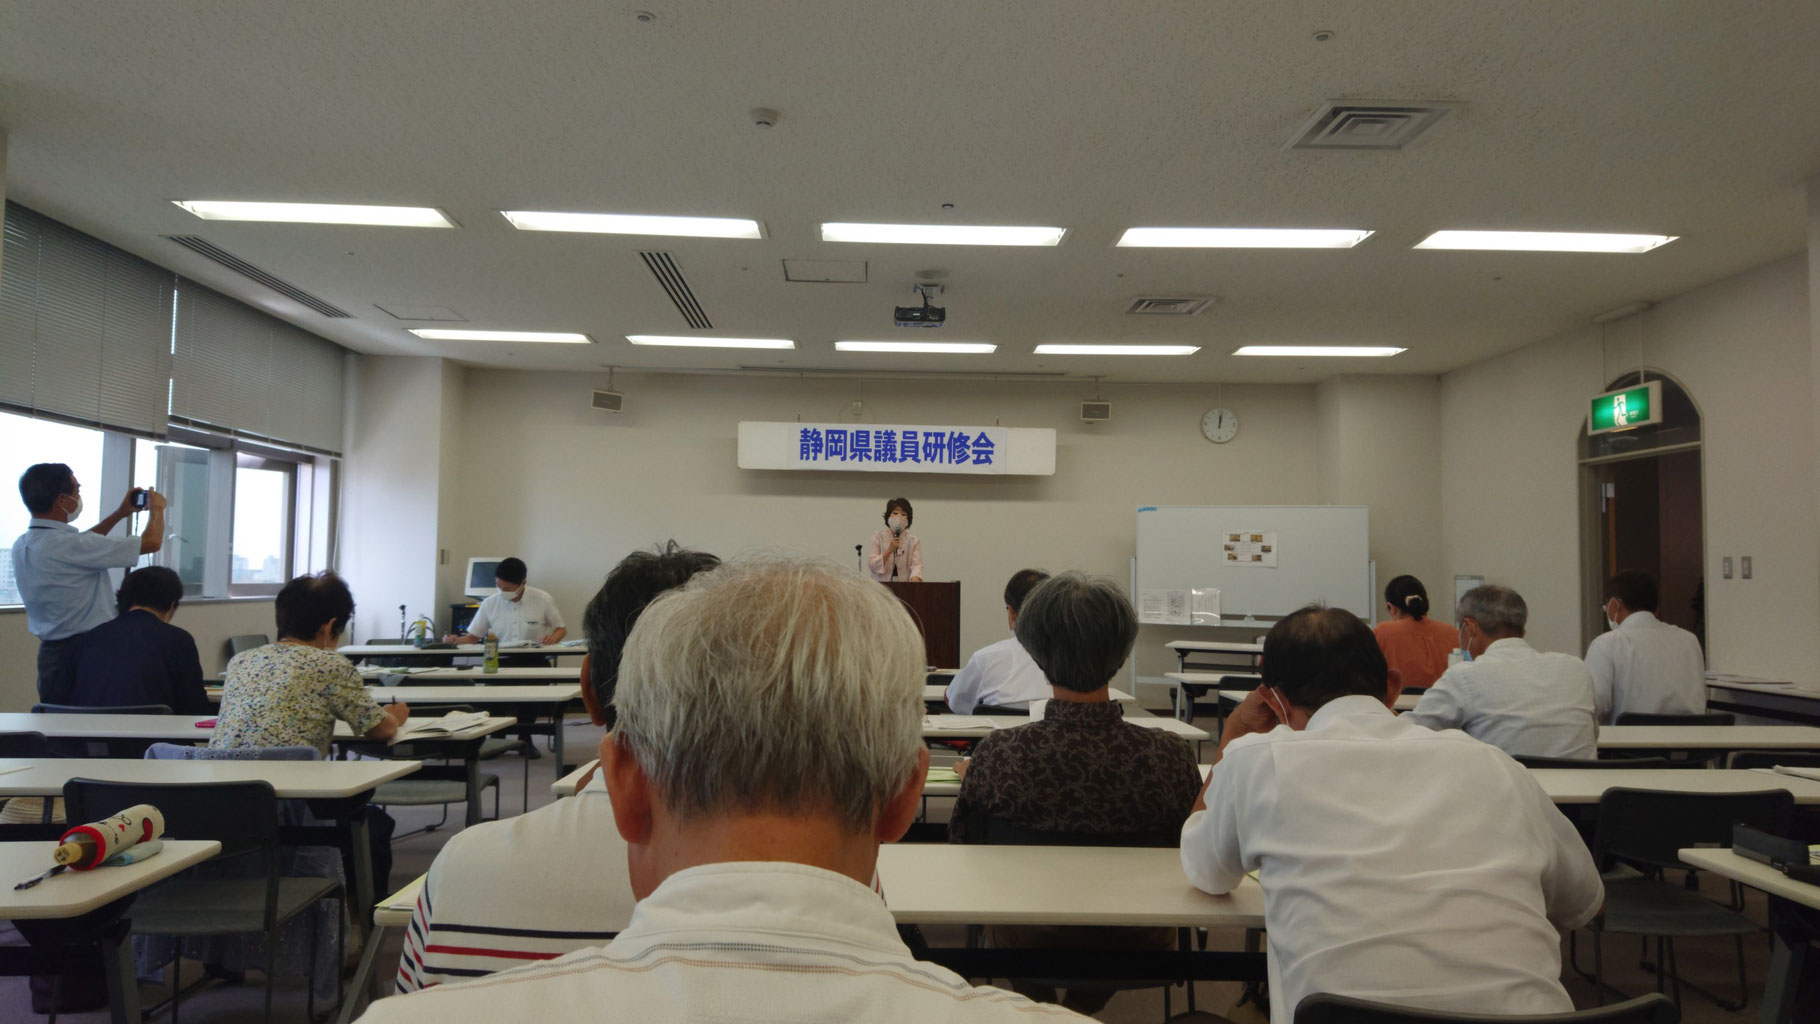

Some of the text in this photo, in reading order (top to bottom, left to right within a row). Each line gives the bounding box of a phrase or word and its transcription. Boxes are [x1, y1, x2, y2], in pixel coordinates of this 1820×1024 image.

[799, 427, 995, 465] 静岡県議員研修会
